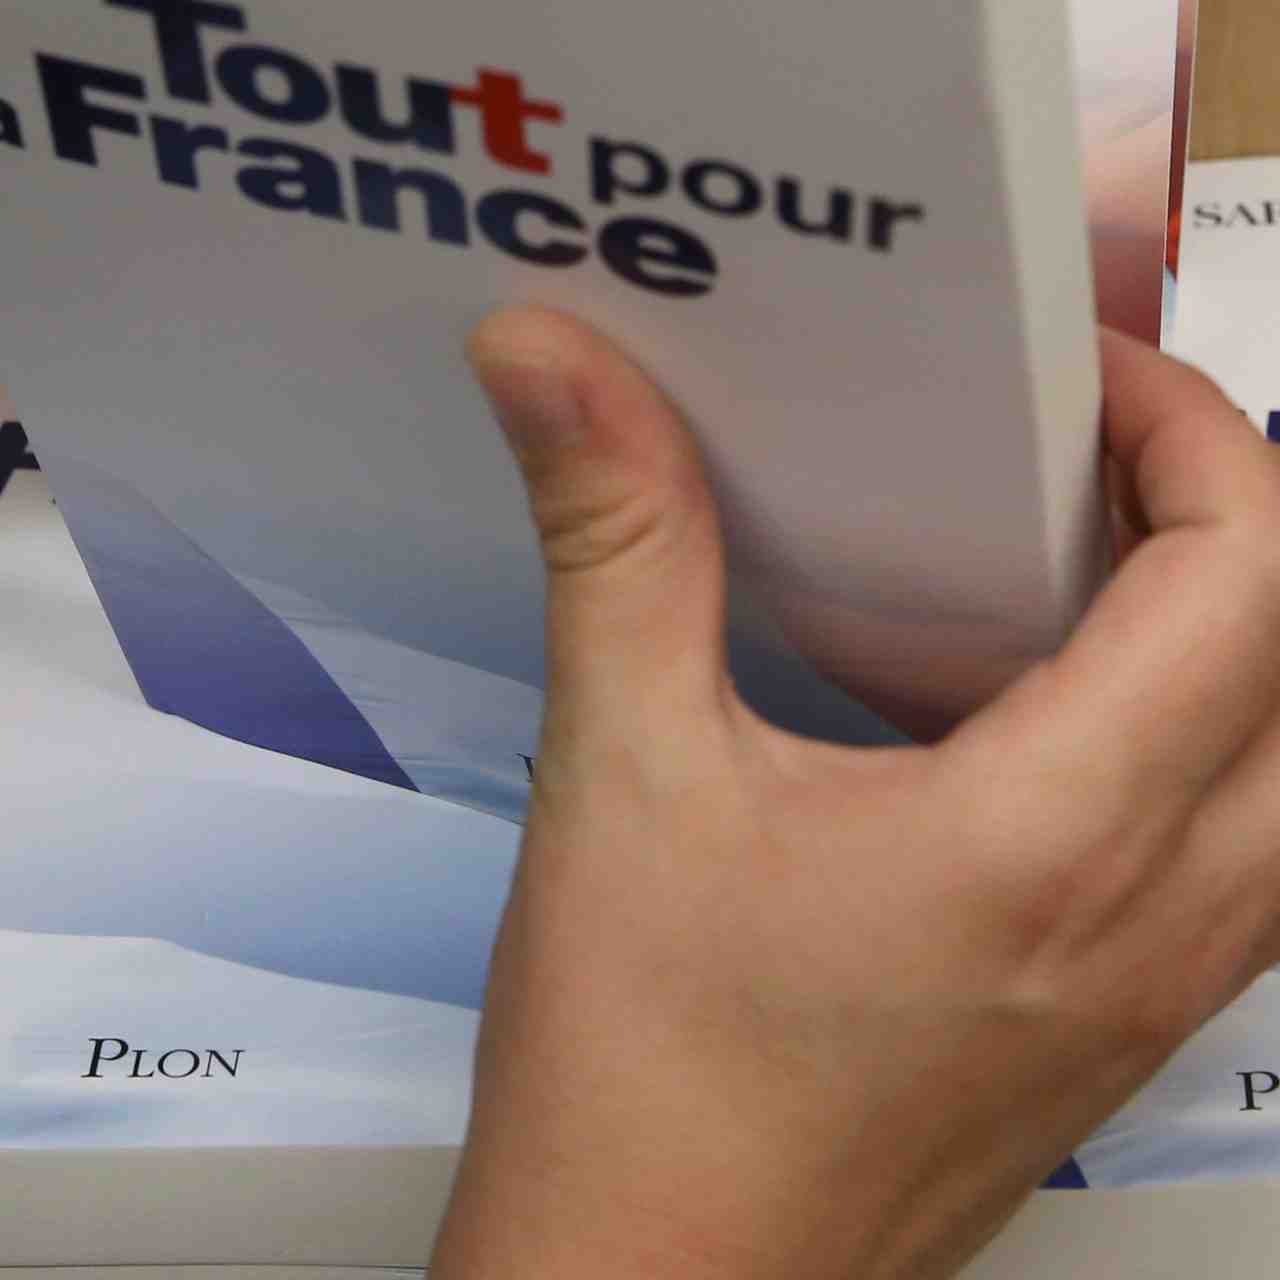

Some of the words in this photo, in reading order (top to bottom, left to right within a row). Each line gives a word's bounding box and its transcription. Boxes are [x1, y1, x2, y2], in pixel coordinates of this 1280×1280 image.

[34, 52, 719, 299] France
[588, 134, 925, 254] pour
[81, 1037, 245, 1079] PLON
